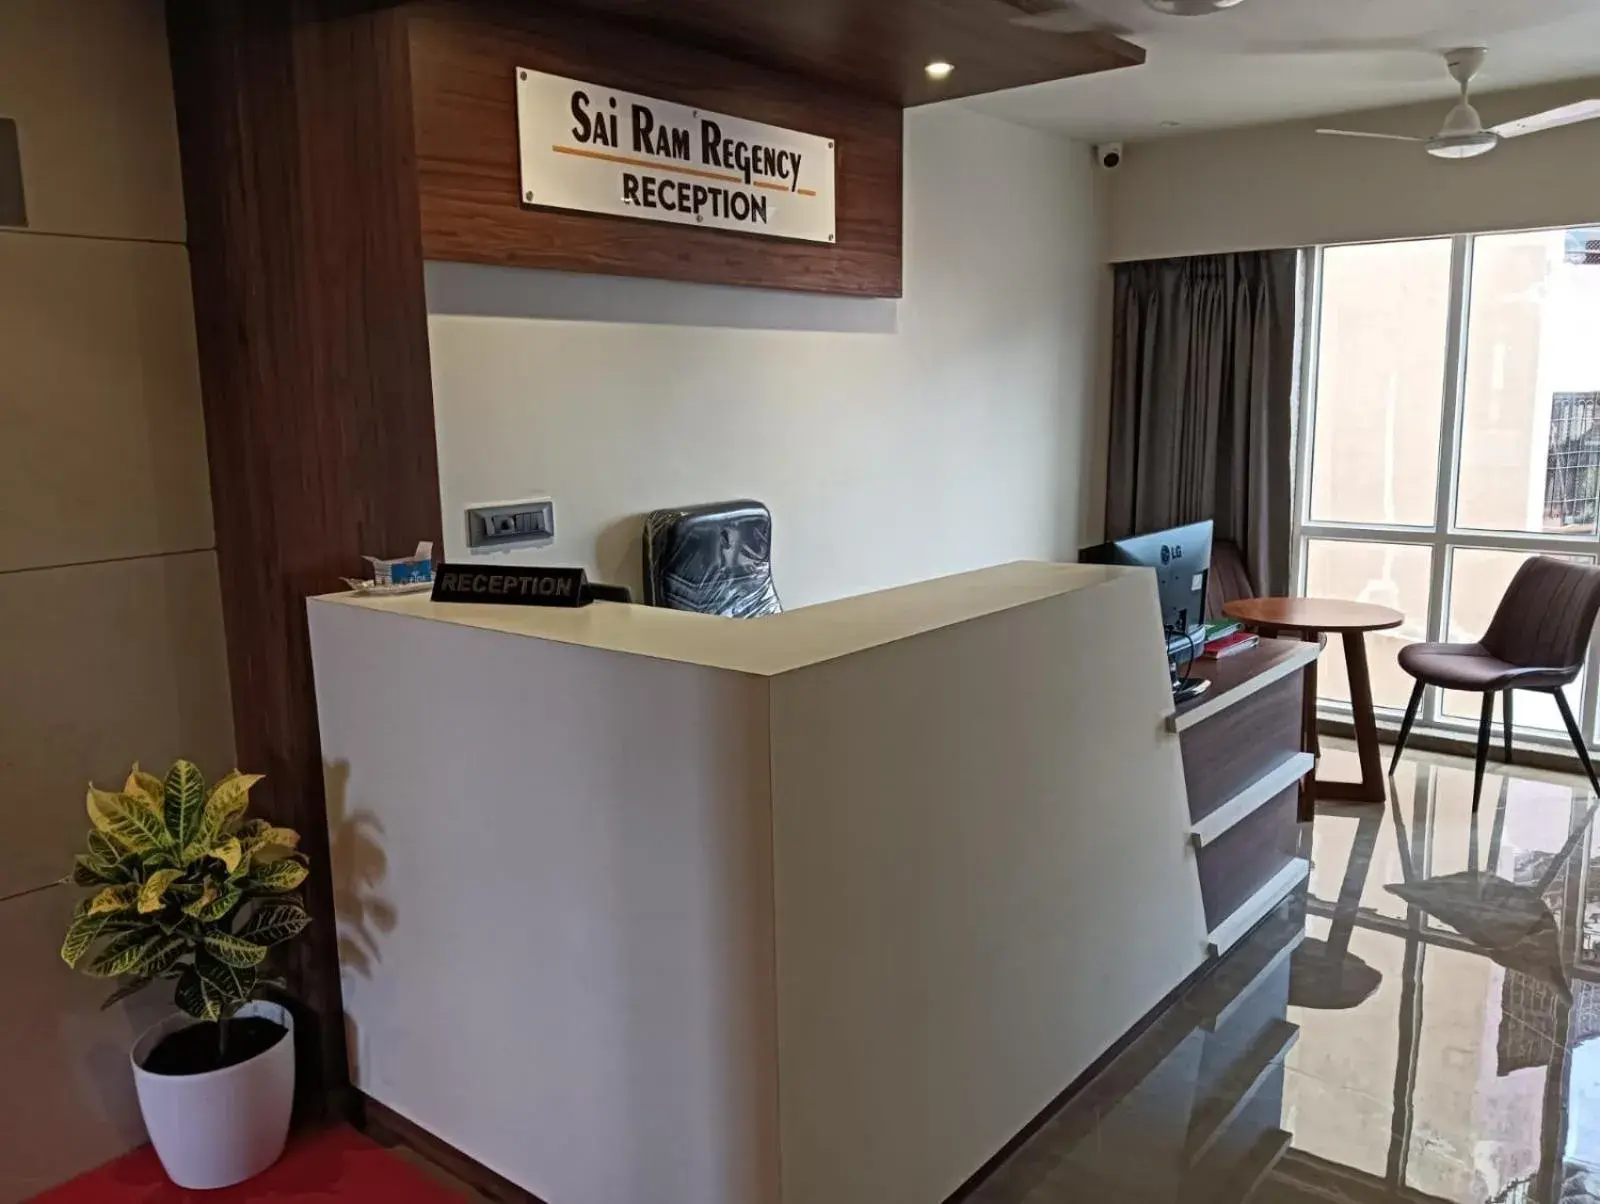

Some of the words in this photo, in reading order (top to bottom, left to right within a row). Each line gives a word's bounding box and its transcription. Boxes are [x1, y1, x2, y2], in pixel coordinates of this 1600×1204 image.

[632, 104, 690, 161] RAM
[623, 173, 767, 224] RECEPTION
[1171, 545, 1182, 559] LG
[442, 573, 572, 597] RECEPTION
